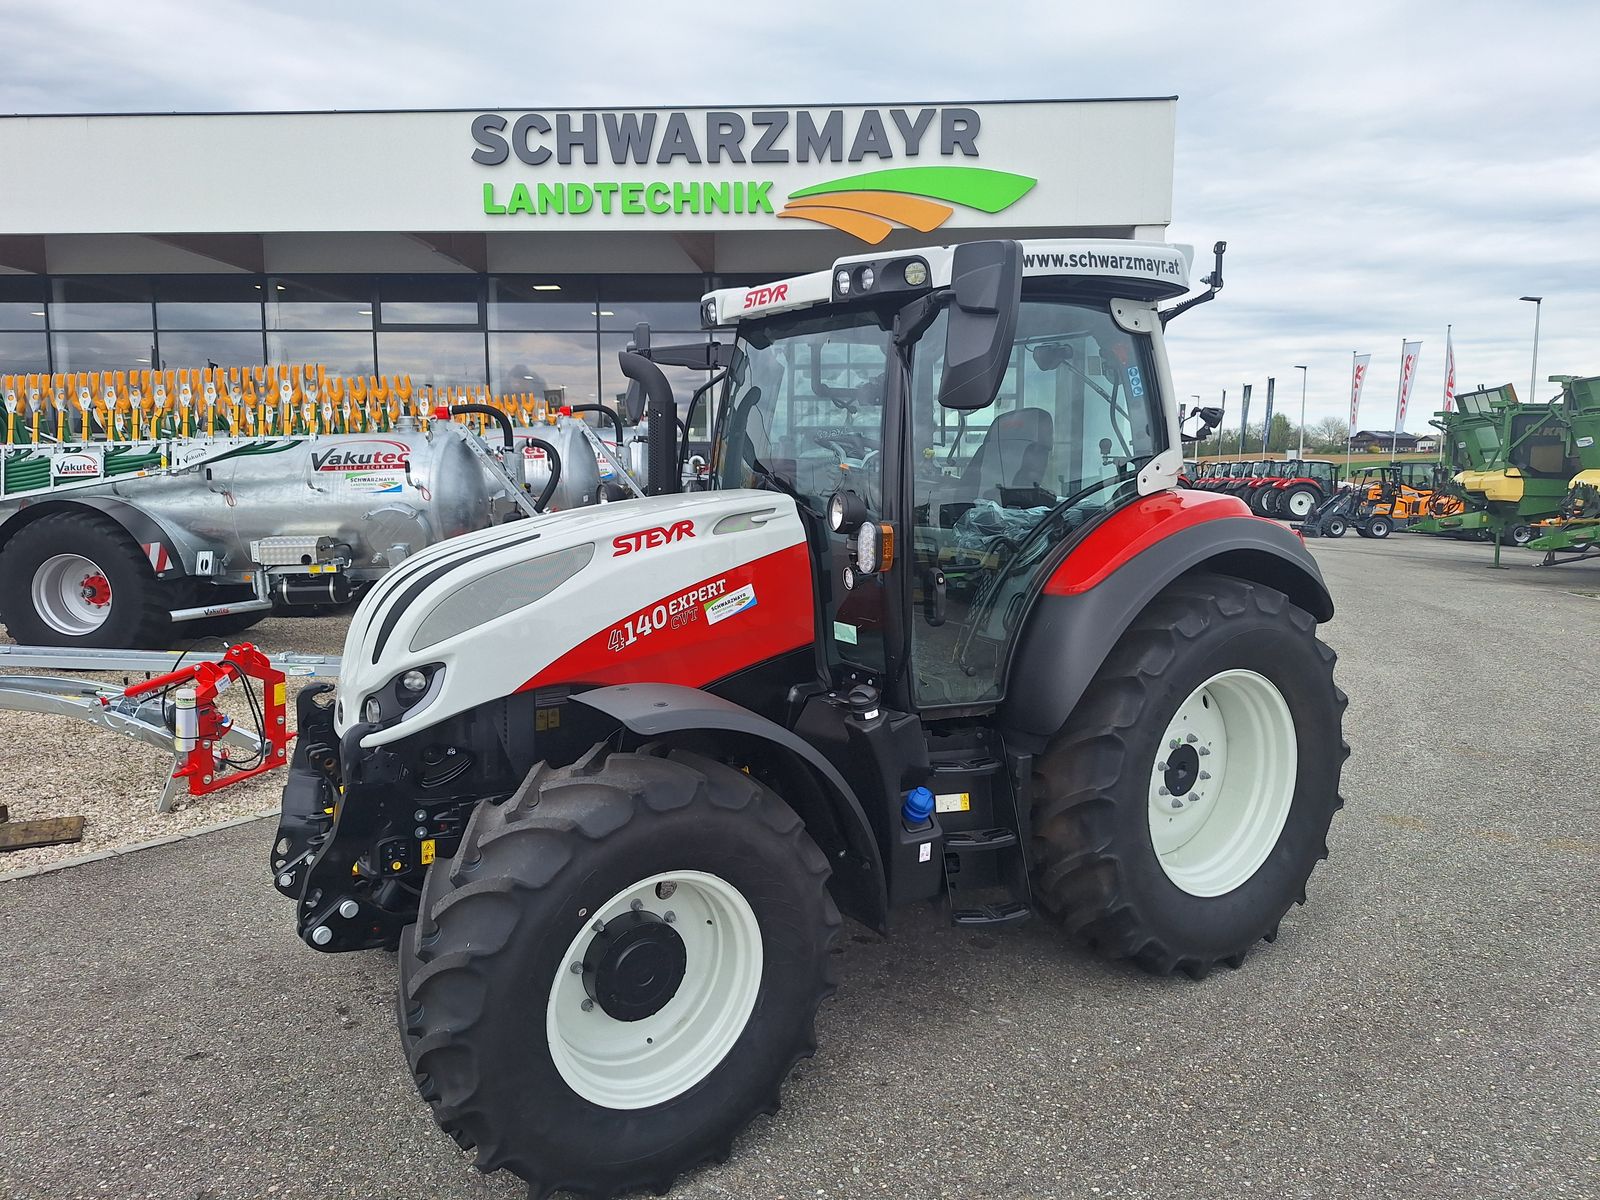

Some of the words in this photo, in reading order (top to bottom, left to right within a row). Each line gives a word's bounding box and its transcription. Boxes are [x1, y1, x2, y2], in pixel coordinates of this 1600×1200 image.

[470, 107, 981, 166] SCHWARZMAYR
[483, 181, 775, 215] LANDTECHNIK
[1023, 250, 1181, 277] www.schwarzmayr.at
[743, 283, 789, 309] STEYR
[55, 460, 98, 475] Vakutec
[310, 447, 410, 472] Vakutec
[612, 519, 697, 558] STEYR
[668, 578, 727, 616] EXPERT
[711, 592, 747, 612] SCHWARZMAYR
[670, 606, 699, 630] CVT
